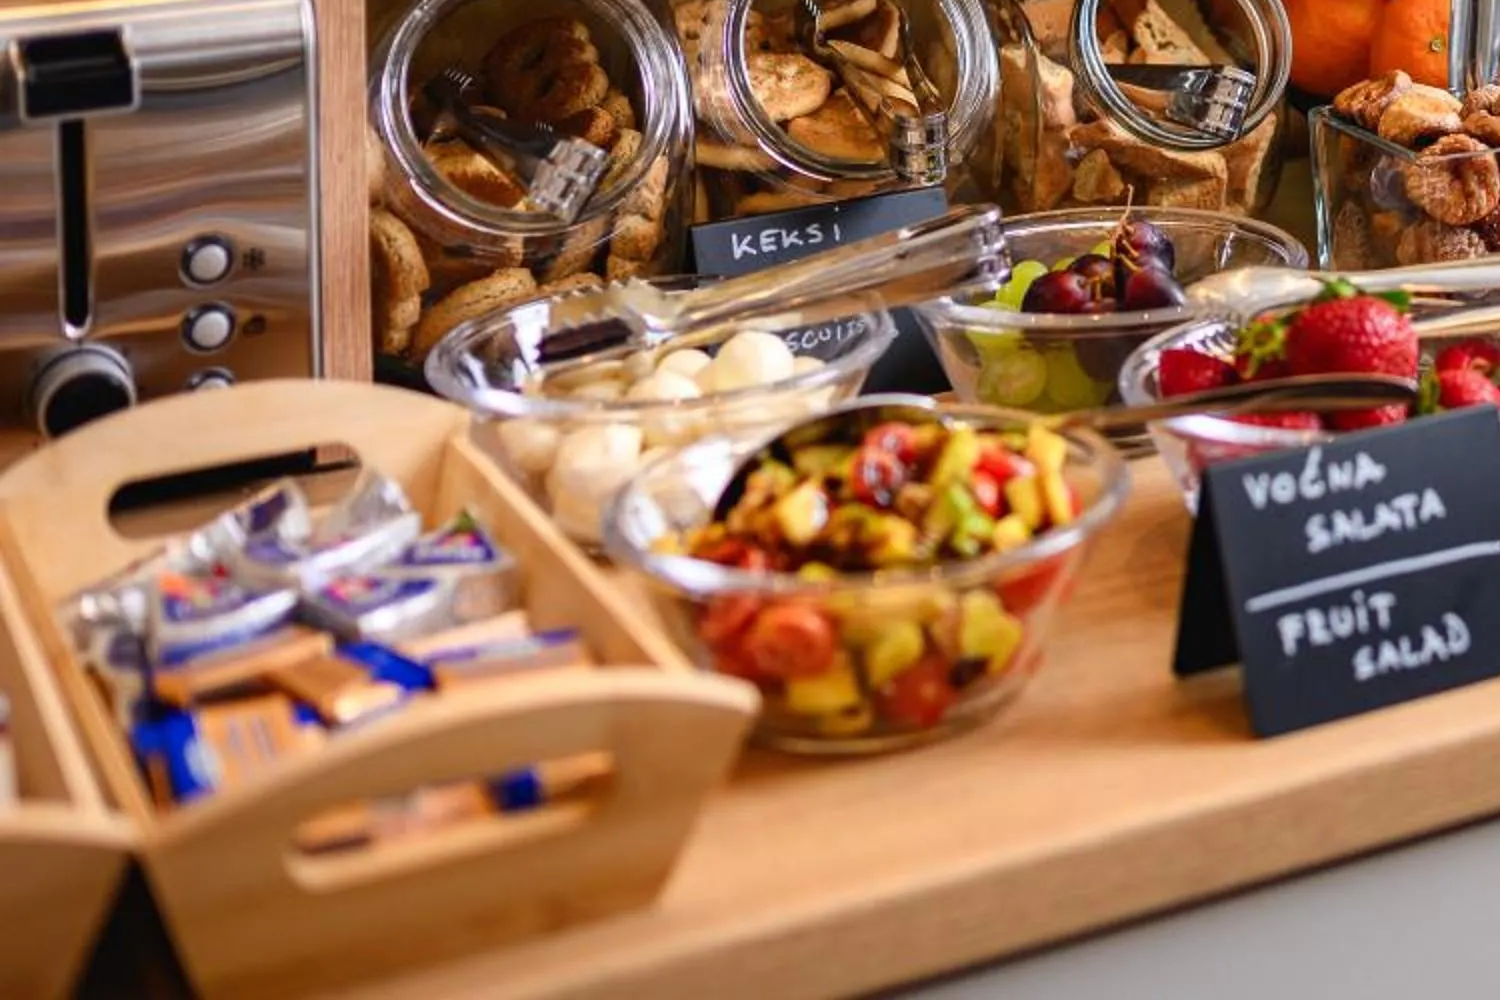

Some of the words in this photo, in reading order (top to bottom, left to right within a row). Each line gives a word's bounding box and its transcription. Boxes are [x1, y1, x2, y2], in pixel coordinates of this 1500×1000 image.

[731, 205, 842, 260] KEKSI
[784, 317, 867, 352] SCUITS
[1304, 486, 1447, 554] SALATA
[1276, 588, 1396, 657] FRUIT
[1352, 610, 1472, 682] SALAD
